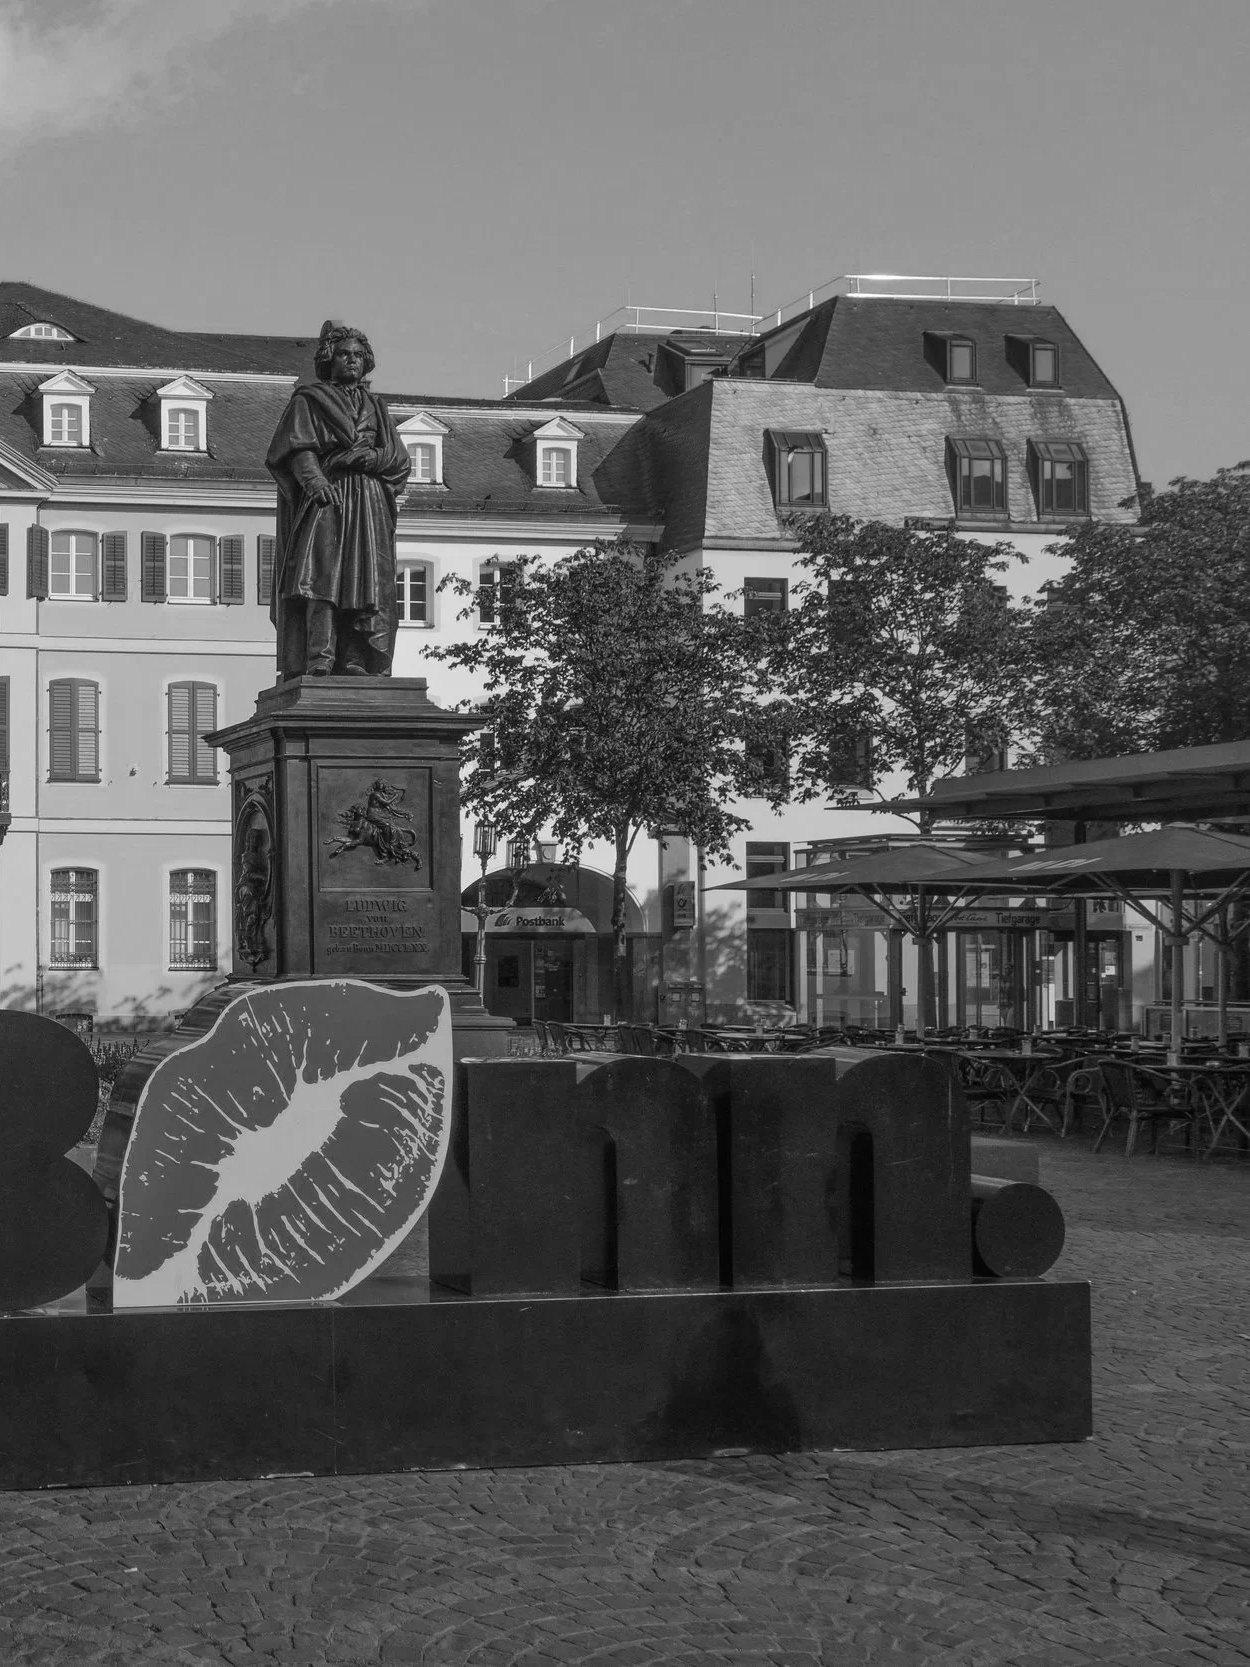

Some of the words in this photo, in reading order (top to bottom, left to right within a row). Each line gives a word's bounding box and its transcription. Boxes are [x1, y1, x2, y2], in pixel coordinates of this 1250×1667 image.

[344, 899, 407, 913] LUDWIG
[516, 915, 566, 928] Postbank
[994, 912, 1040, 926] Tiefgarage
